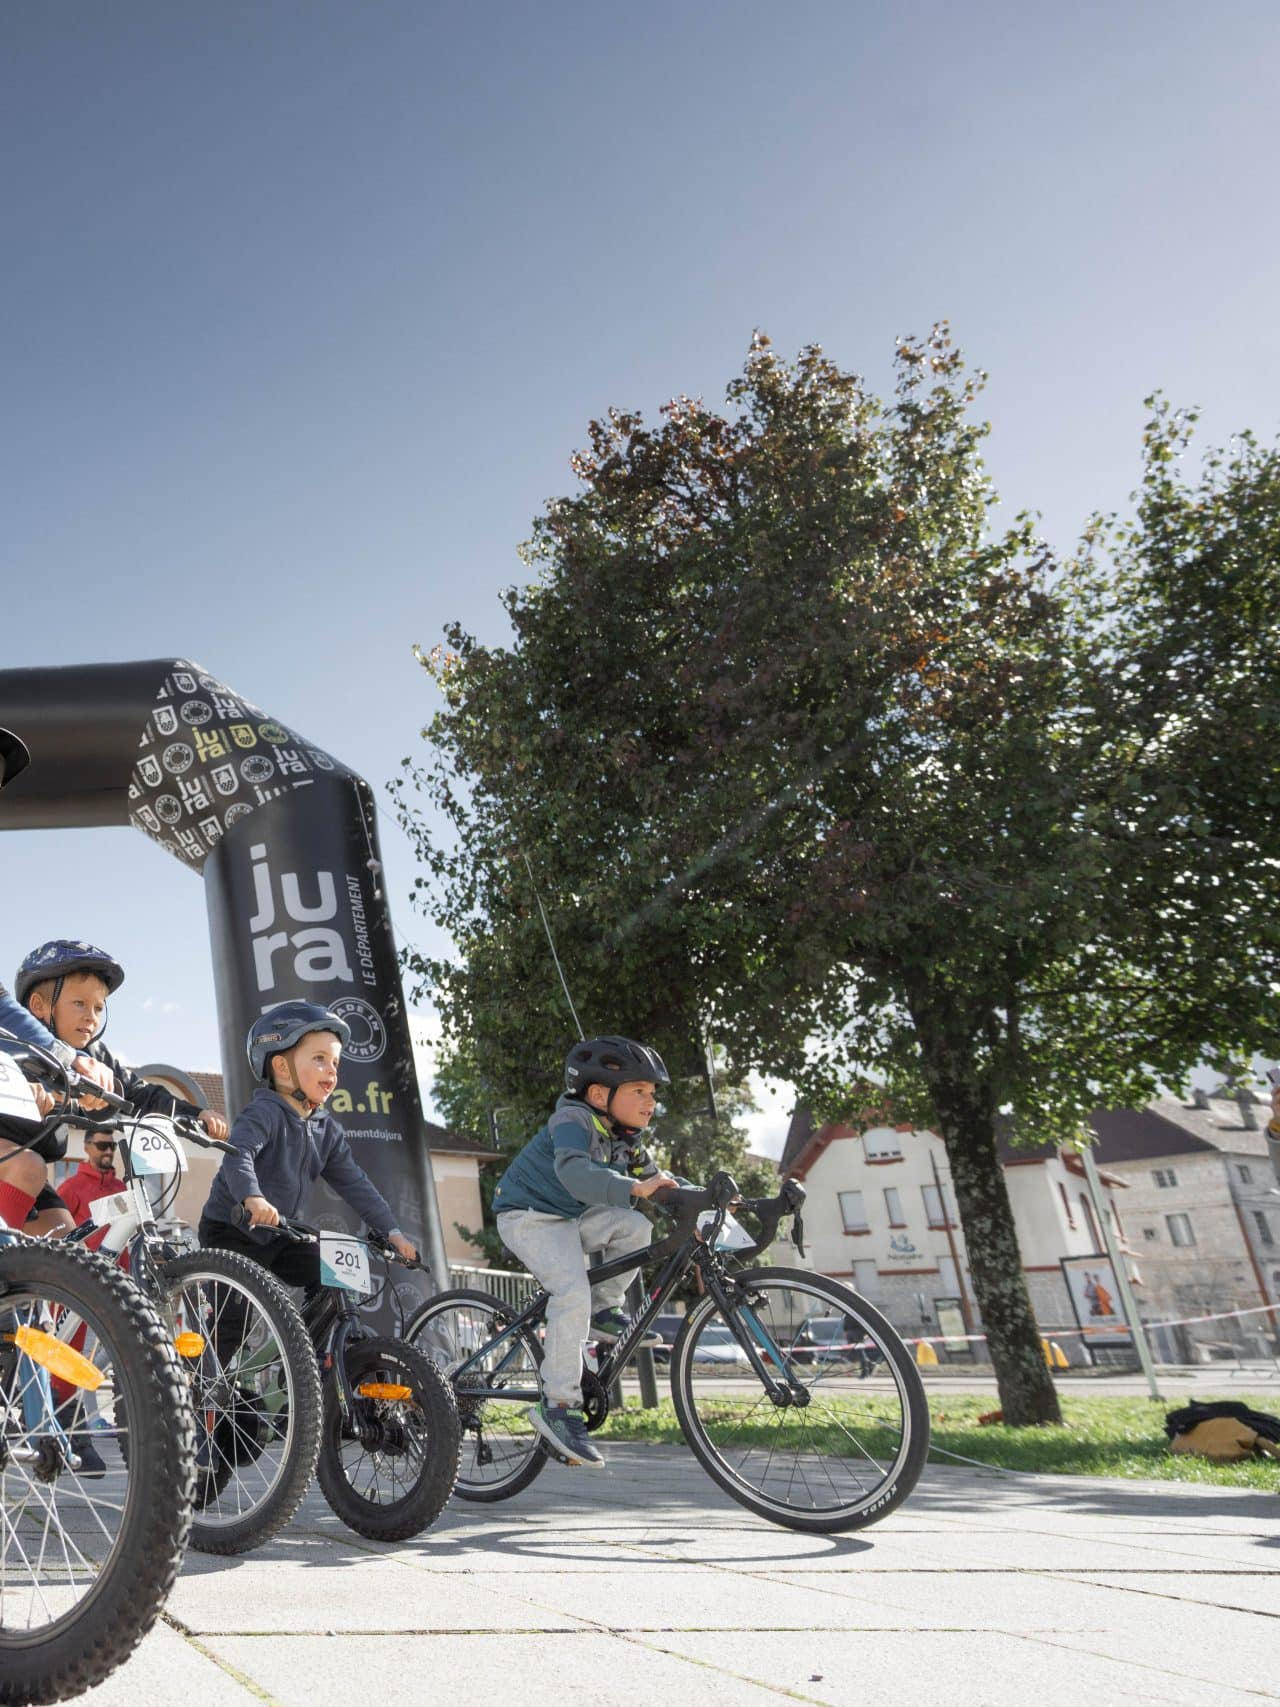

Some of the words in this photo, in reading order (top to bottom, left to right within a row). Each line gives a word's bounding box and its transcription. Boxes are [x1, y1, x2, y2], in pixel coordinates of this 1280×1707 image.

[191, 726, 219, 748] ju
[197, 743, 226, 763] ra
[249, 843, 338, 933] ju
[346, 874, 374, 969] DÉPARTEMENT
[251, 926, 354, 992] ra
[362, 969, 377, 986] LE
[336, 1004, 364, 1016] ADE
[347, 1044, 378, 1056] URA
[320, 1081, 394, 1115] a.fr
[343, 1127, 402, 1141] ementdujura
[335, 1250, 361, 1270] 201
[862, 1484, 898, 1517] KENDA
